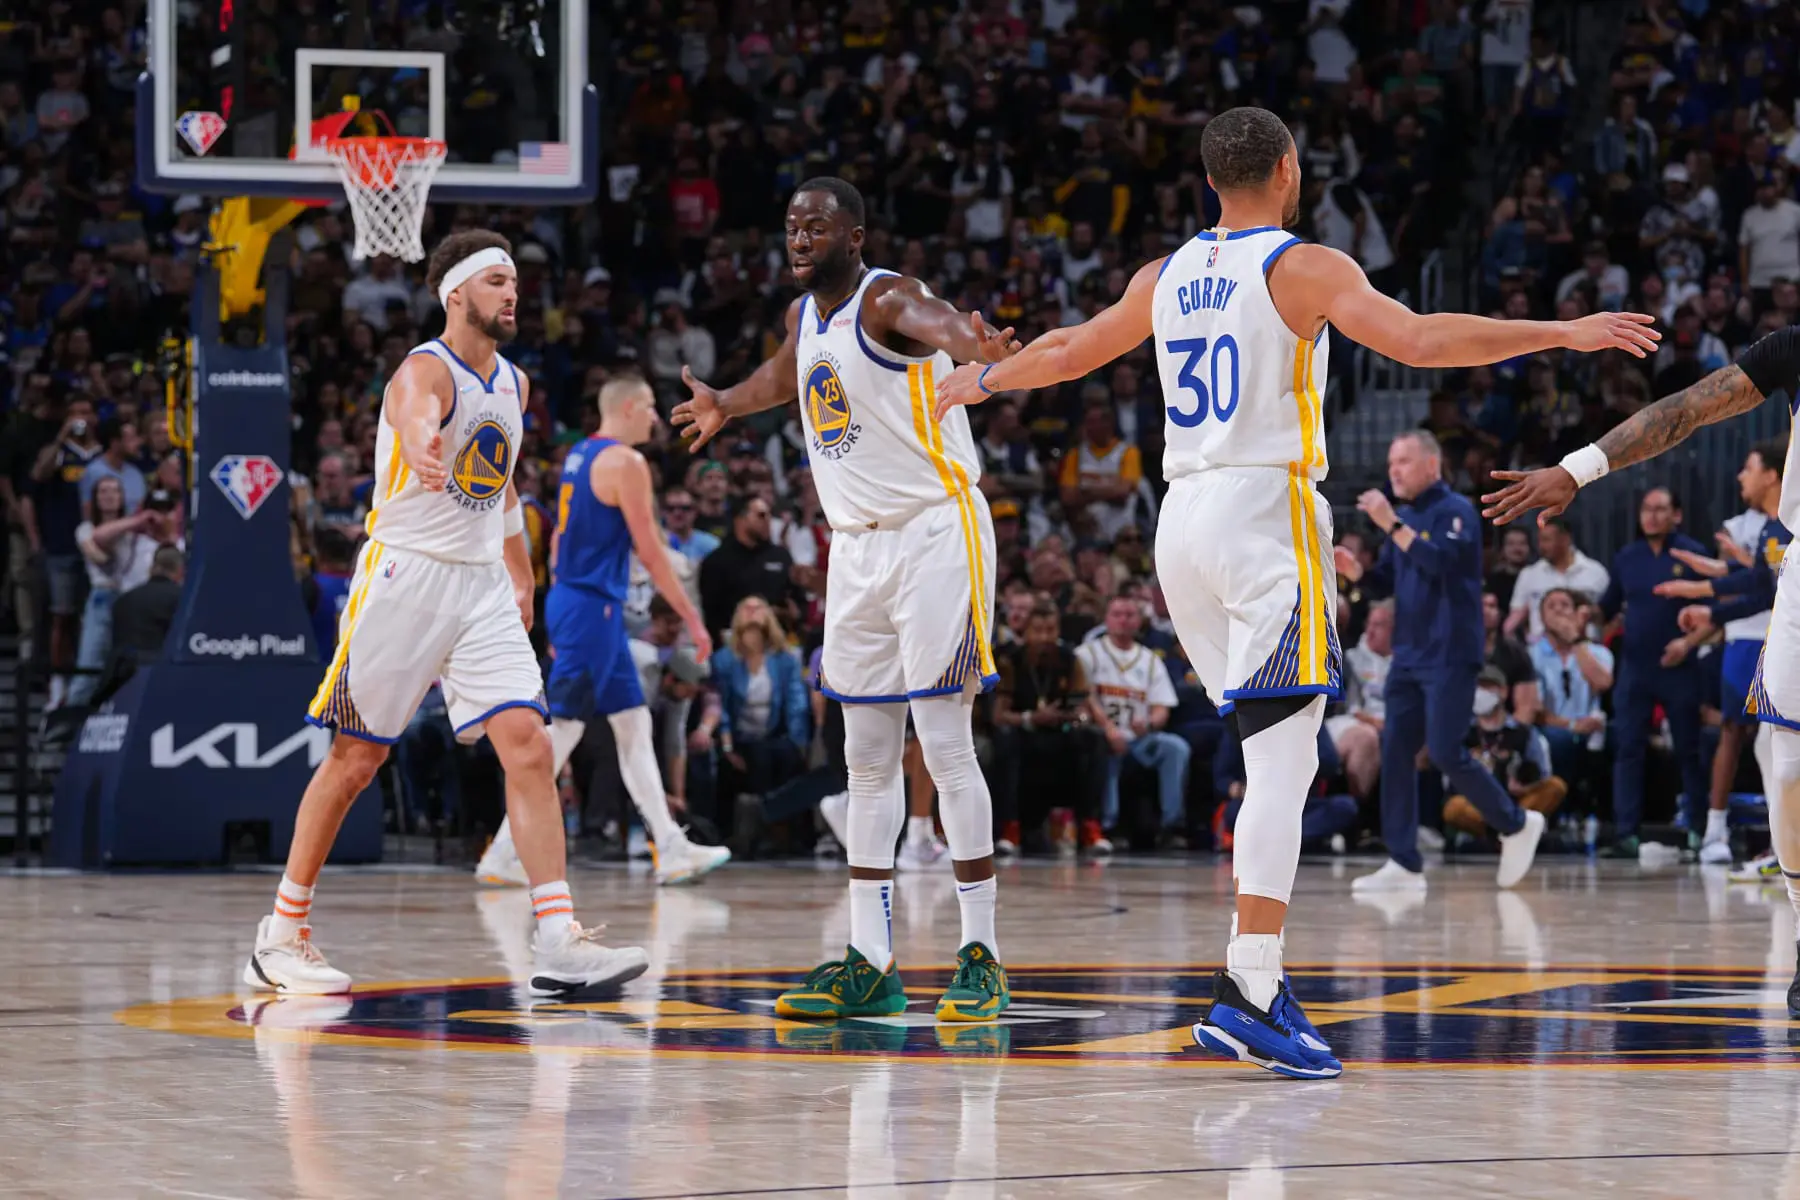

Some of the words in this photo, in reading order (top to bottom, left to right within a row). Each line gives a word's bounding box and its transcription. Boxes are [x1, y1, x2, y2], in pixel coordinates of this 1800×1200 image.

[1177, 277, 1238, 316] CURRY
[207, 369, 285, 387] coinbase
[822, 377, 841, 405] 23
[1165, 333, 1240, 429] 30
[494, 442, 505, 465] 11
[188, 632, 259, 660] Google
[260, 633, 306, 656] Pixel
[150, 722, 333, 768] KIA
